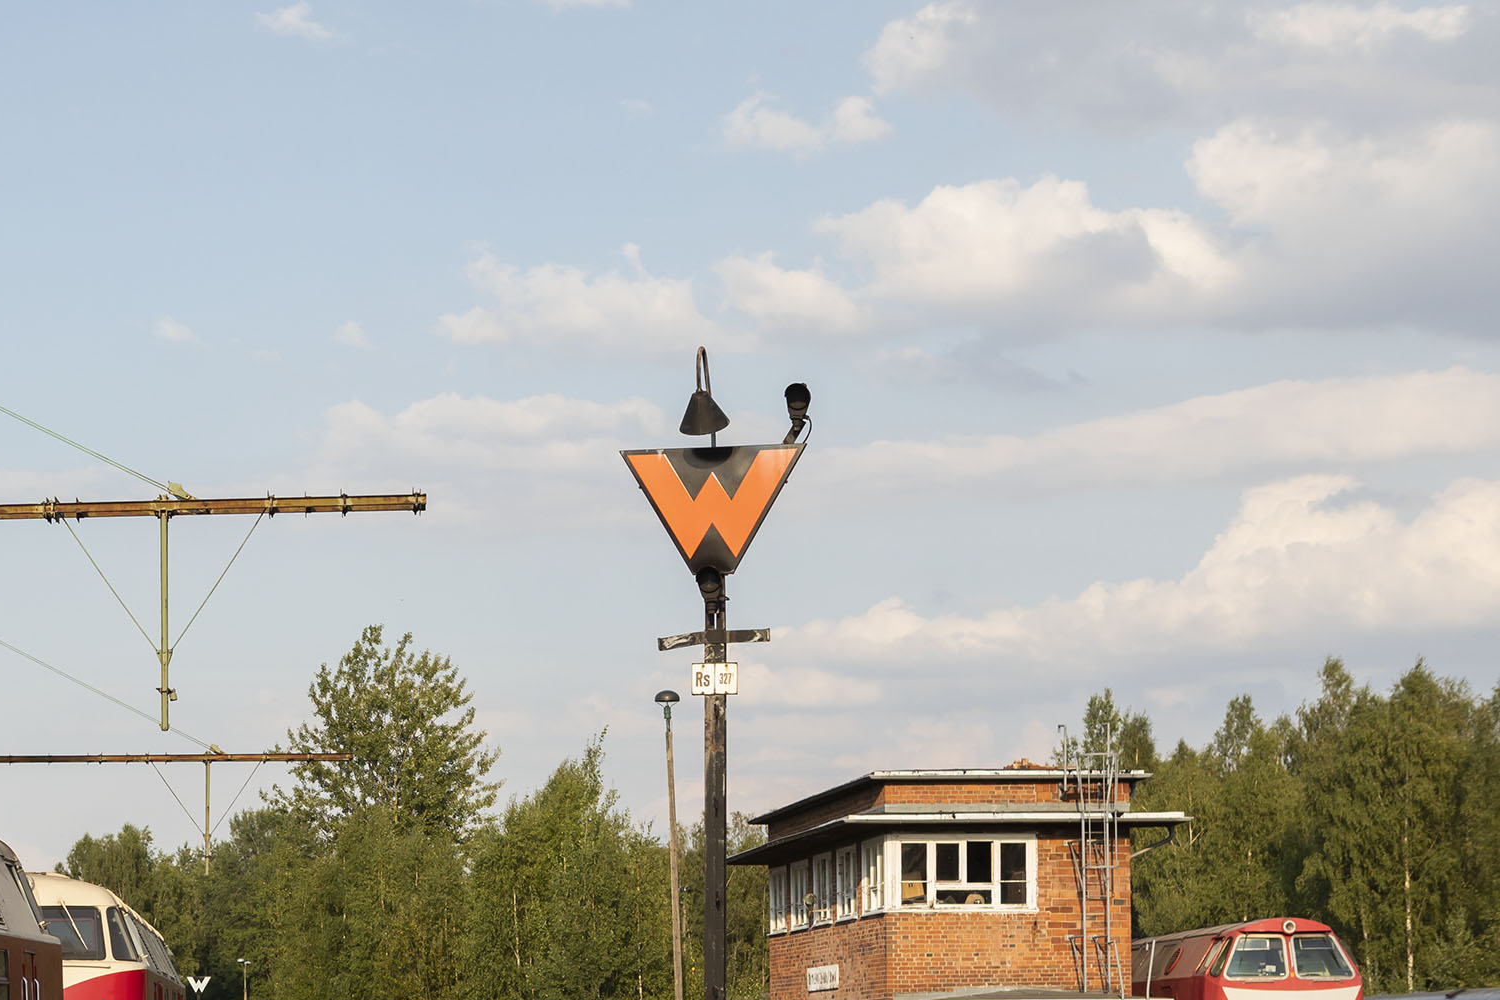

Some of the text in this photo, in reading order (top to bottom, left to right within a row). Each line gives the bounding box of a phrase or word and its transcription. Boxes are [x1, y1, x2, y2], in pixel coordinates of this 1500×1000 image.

[627, 447, 798, 560] W
[695, 671, 711, 688] Rs
[186, 976, 212, 993] W
